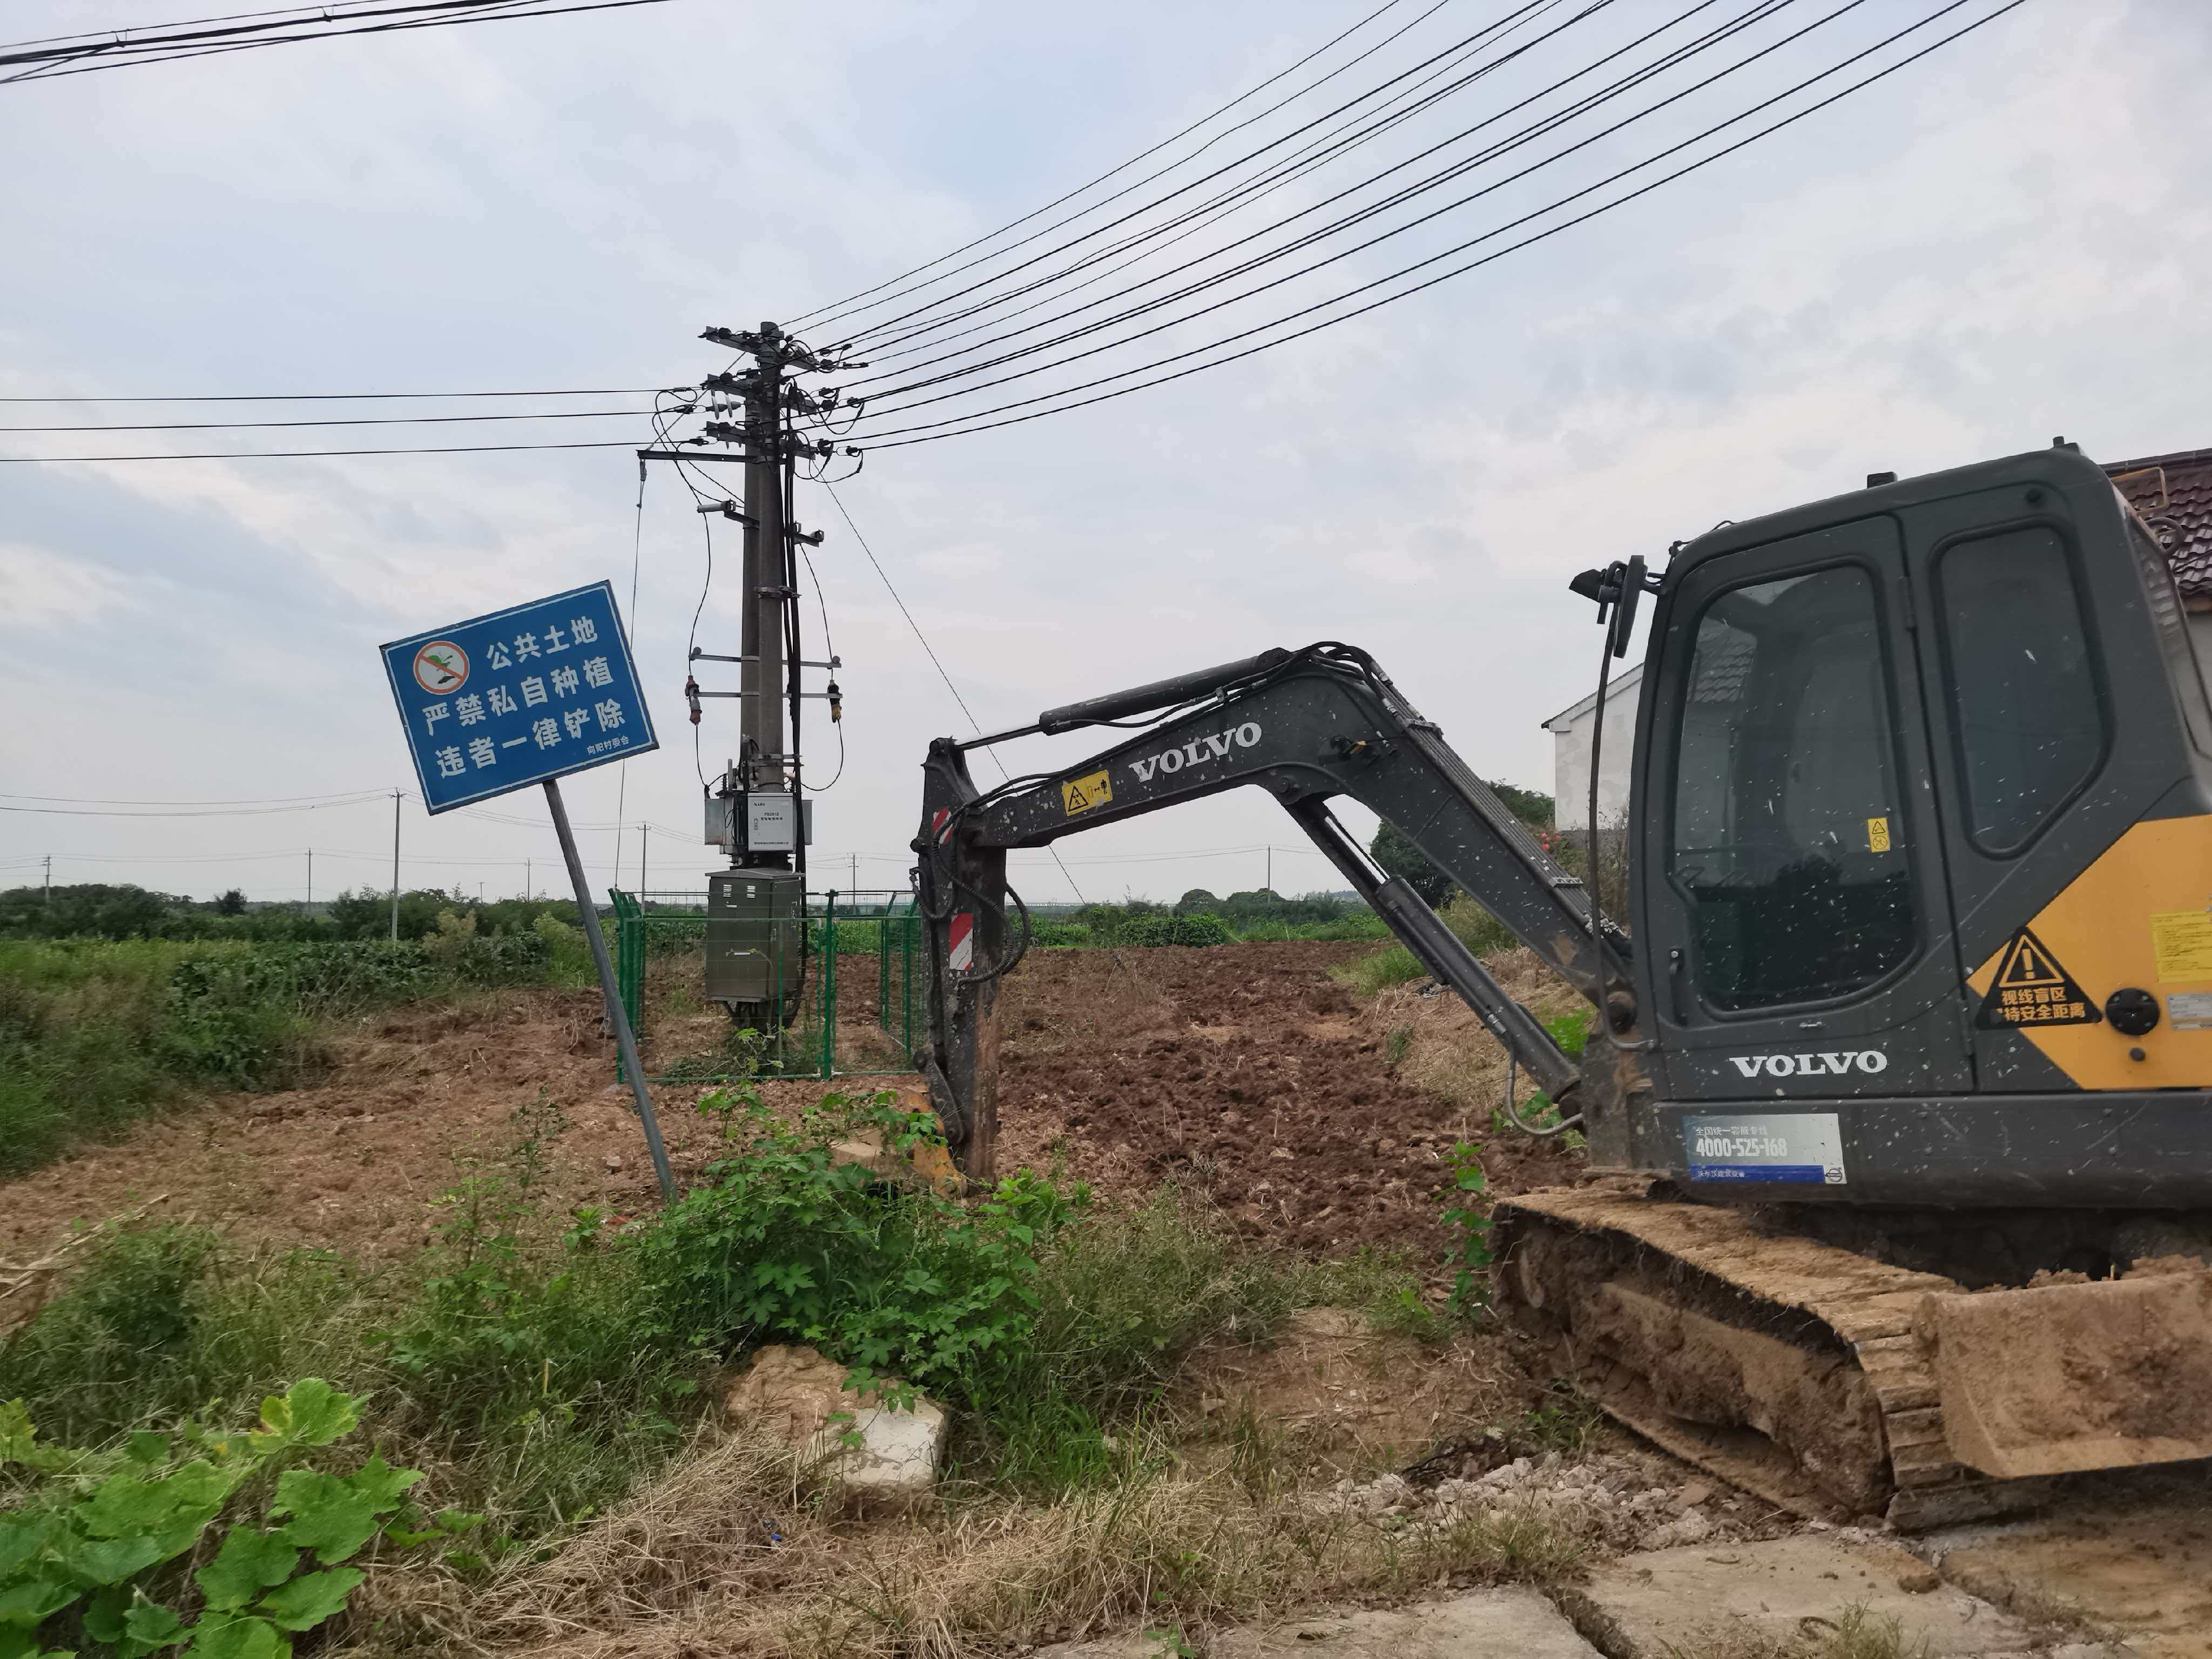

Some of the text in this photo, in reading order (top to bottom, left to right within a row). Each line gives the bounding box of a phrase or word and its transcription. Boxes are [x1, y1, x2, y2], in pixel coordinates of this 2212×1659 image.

[487, 616, 598, 671] 公共土地
[421, 656, 614, 737] 严禁私自种植
[434, 698, 626, 779] 违者一律铲除
[586, 734, 629, 756] 向阳村委会
[1128, 722, 1262, 783] VOLVO
[2001, 987, 2067, 1006] 视线盲区
[1995, 1002, 2086, 1022] 持安全距离
[1729, 1050, 1888, 1078] VOLVO
[1696, 1137, 1788, 1157] 4000-525-168
